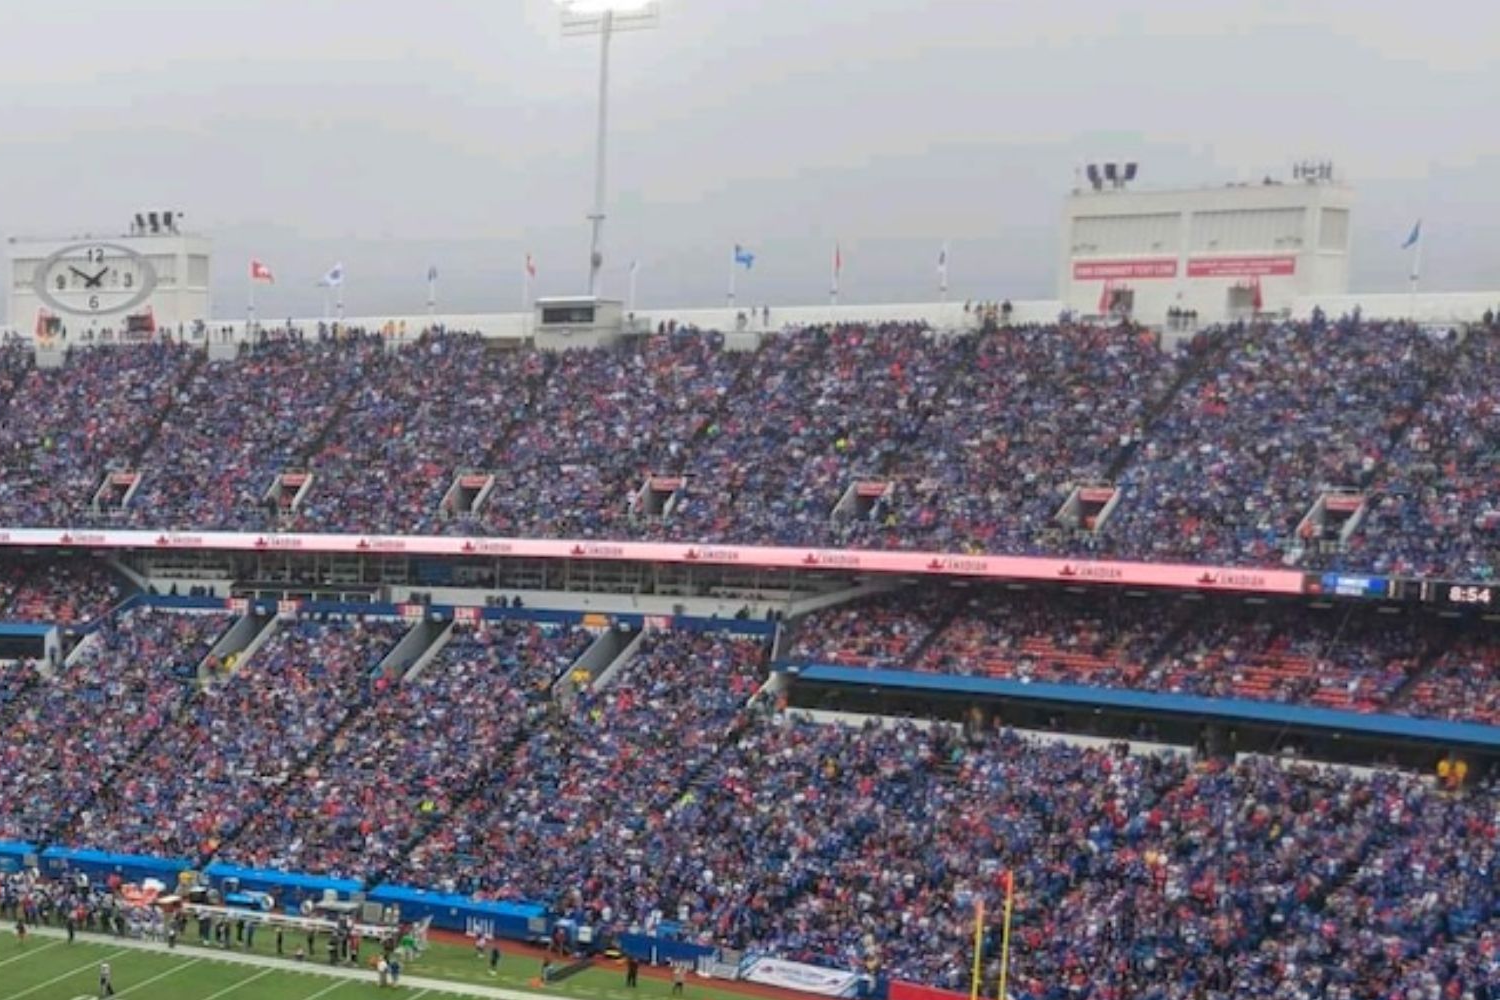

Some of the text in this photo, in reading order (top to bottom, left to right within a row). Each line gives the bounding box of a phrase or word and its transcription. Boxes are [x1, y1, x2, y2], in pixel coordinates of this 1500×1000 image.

[88, 248, 104, 264] 12
[56, 274, 66, 290] 9
[124, 271, 133, 288] 3
[89, 295, 100, 309] 6
[1449, 585, 1491, 603] 8:54
